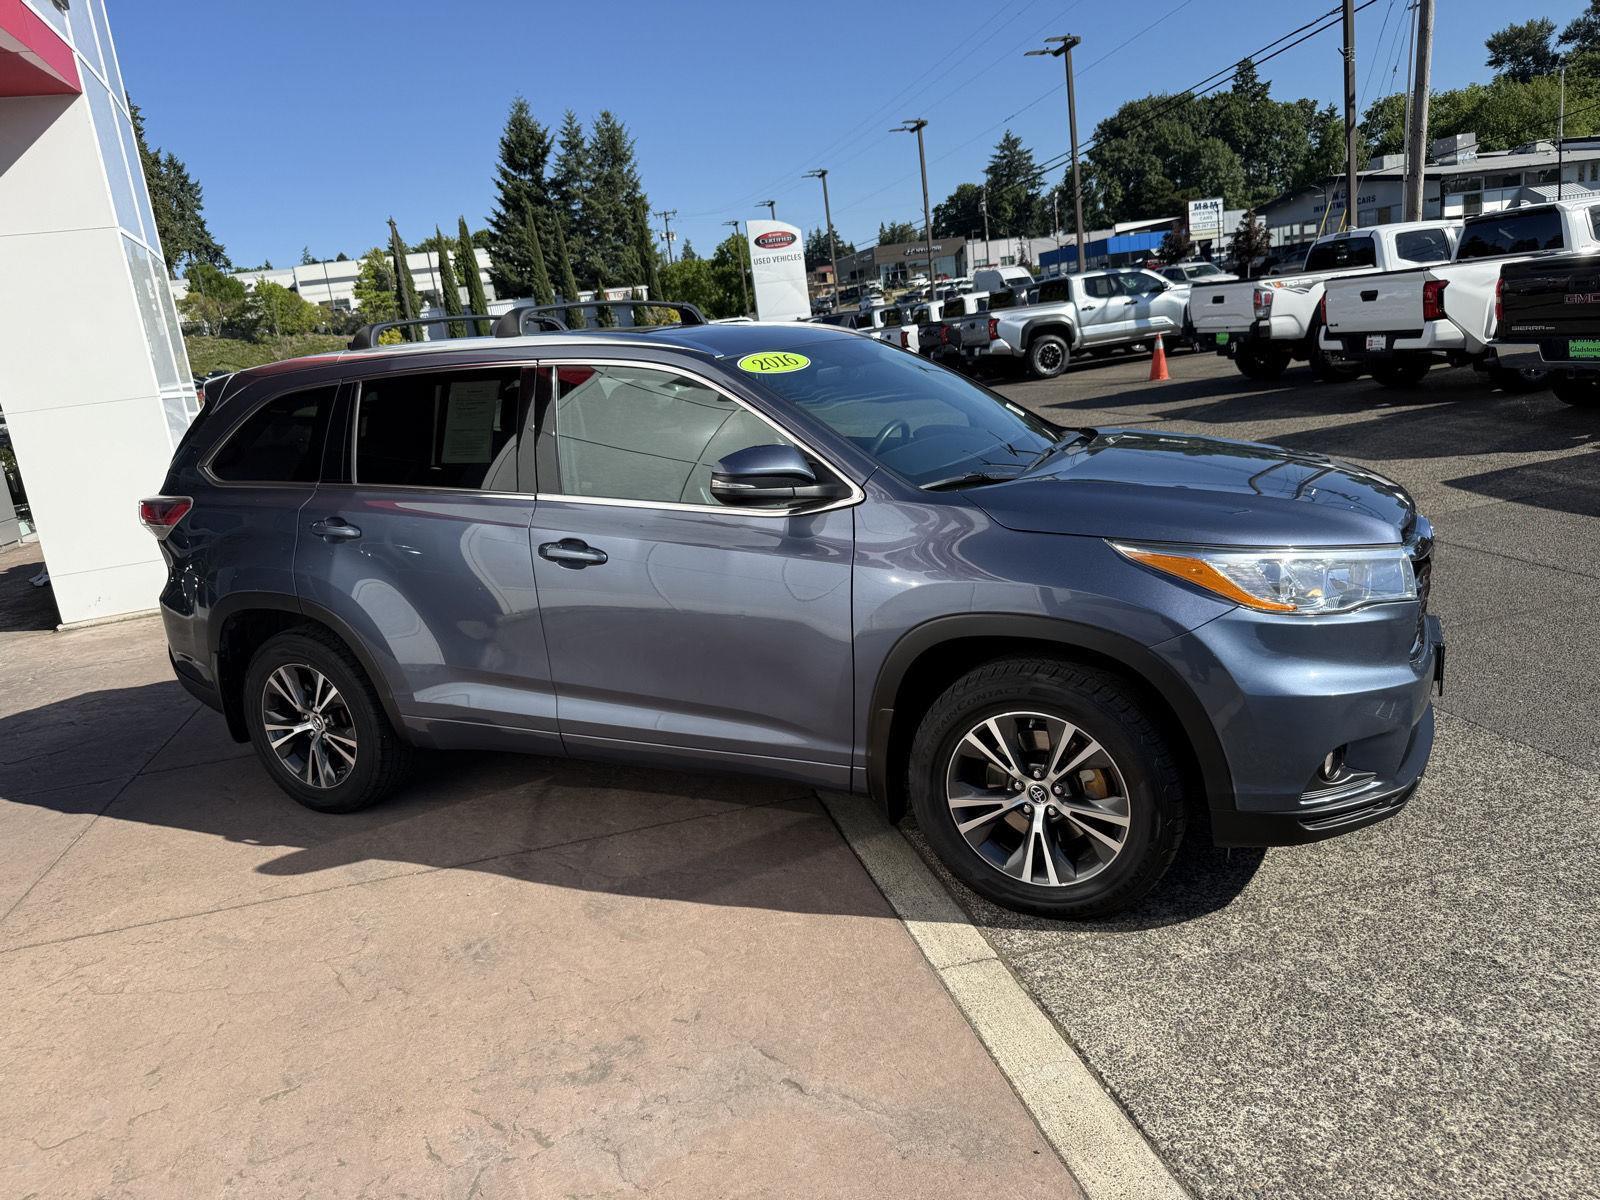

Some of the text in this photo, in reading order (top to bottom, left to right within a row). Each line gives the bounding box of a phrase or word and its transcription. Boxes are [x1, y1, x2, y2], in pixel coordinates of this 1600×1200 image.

[1357, 194, 1377, 205] CARS
[753, 253, 802, 265] USED VEHICLES
[1564, 292, 1600, 304] GMC
[752, 354, 800, 371] 2016
